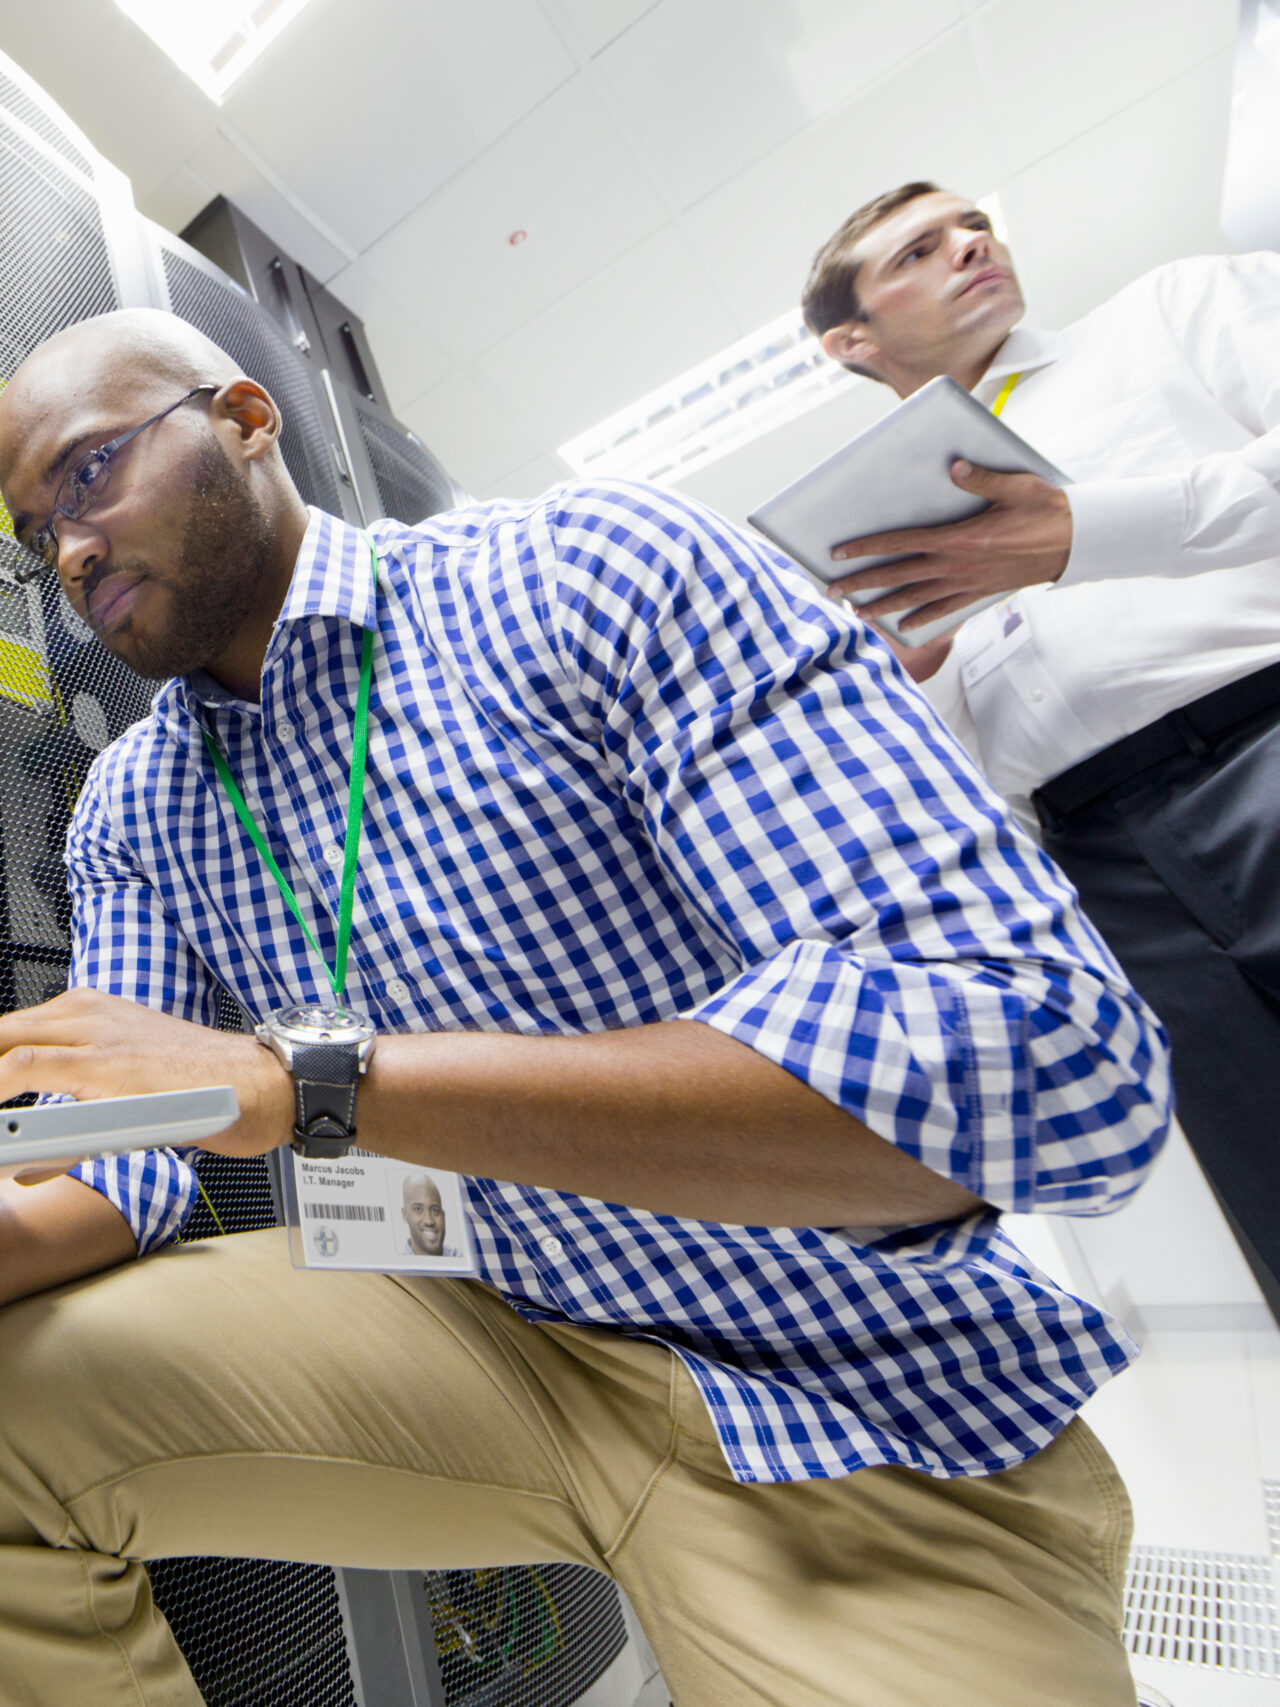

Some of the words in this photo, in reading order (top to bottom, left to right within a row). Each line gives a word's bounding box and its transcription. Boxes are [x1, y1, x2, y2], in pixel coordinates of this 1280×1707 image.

[302, 1163, 333, 1174] Marcus
[335, 1165, 365, 1176] Jacobs
[303, 1176, 317, 1186] I.T.
[319, 1177, 355, 1189] Manager
